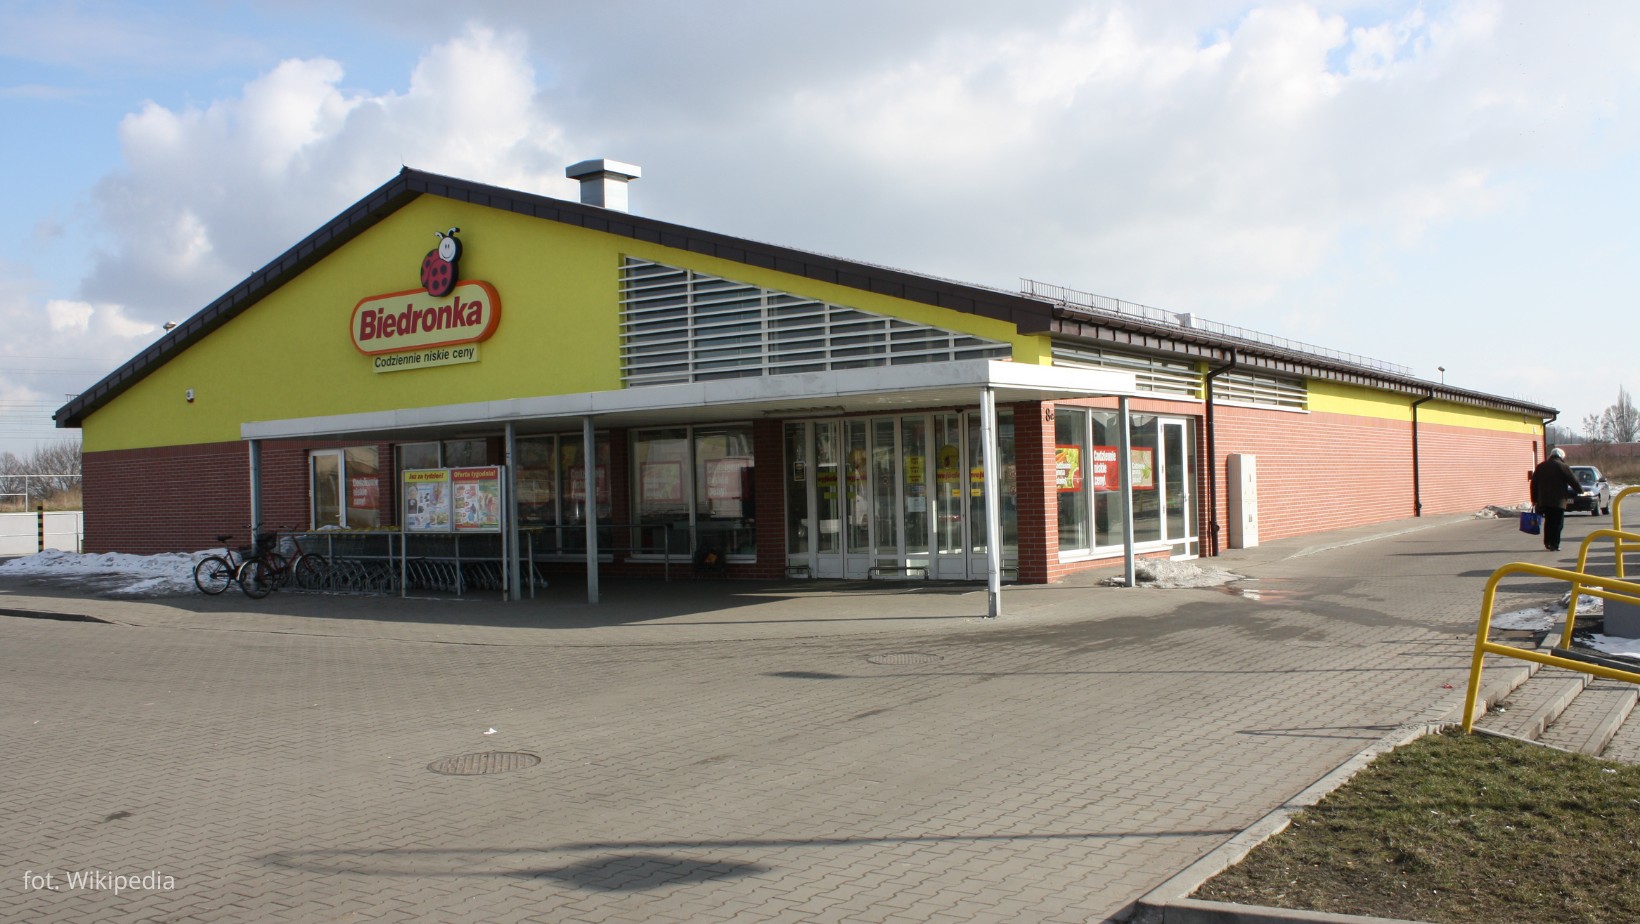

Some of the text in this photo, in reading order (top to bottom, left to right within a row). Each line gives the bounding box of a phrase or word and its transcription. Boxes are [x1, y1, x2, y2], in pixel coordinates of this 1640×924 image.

[360, 296, 483, 341] Biedronka
[374, 347, 475, 368] Codziennie niskie ceny
